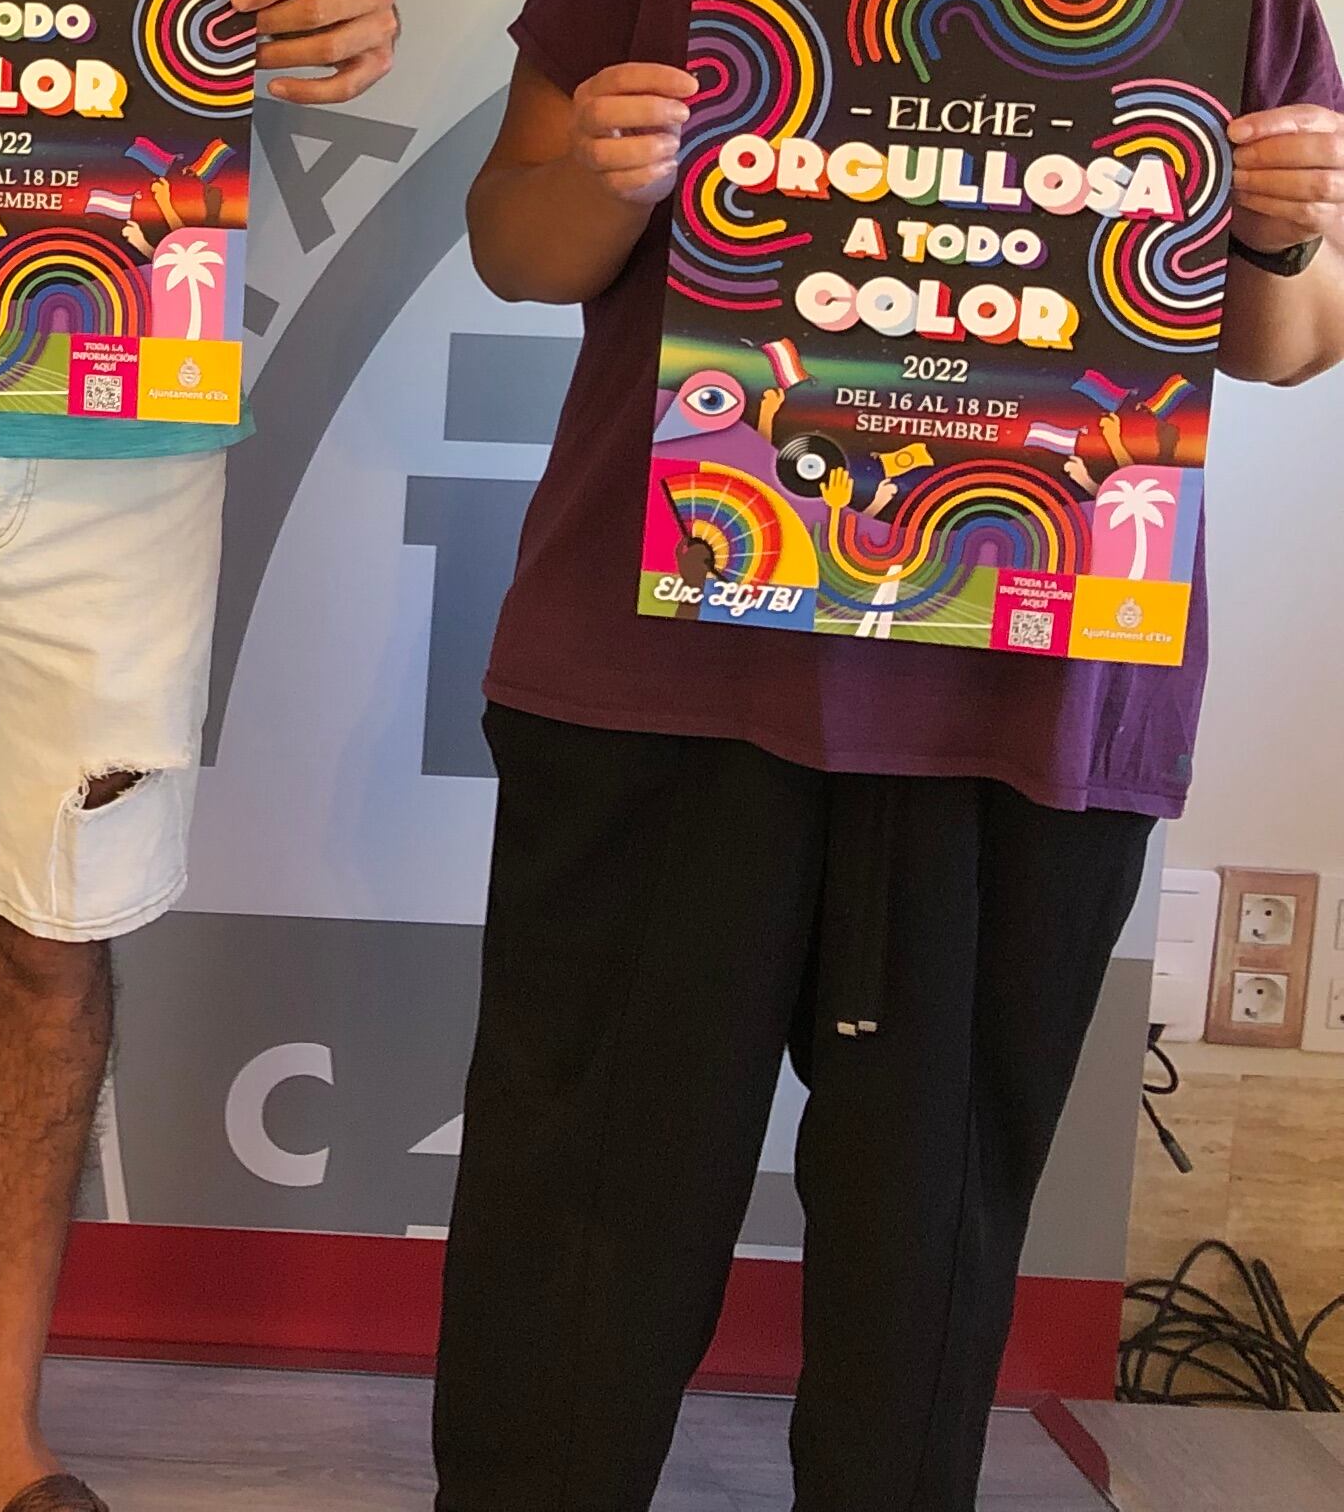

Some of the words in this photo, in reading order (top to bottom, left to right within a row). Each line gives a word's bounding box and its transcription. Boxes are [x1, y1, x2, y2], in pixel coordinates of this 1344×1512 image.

[887, 91, 1036, 137] ELCHE
[23, 168, 44, 186] 18
[50, 169, 79, 187] DE
[717, 133, 1191, 223] ORGULLOSA
[843, 216, 890, 260] A
[894, 220, 1050, 271] TODO
[792, 270, 1081, 350] COLOR
[901, 354, 969, 383] 2022
[148, 387, 203, 401] Ajuntament
[835, 387, 882, 407] DEL
[889, 391, 912, 410] 16
[916, 394, 949, 413] AL
[955, 396, 980, 415] 18
[986, 398, 1019, 418] DE
[855, 412, 999, 442] SEPTIEMBRE
[652, 575, 705, 604] Elx
[707, 579, 803, 623] LGTBI
[1081, 626, 1143, 644] Ajuntament
